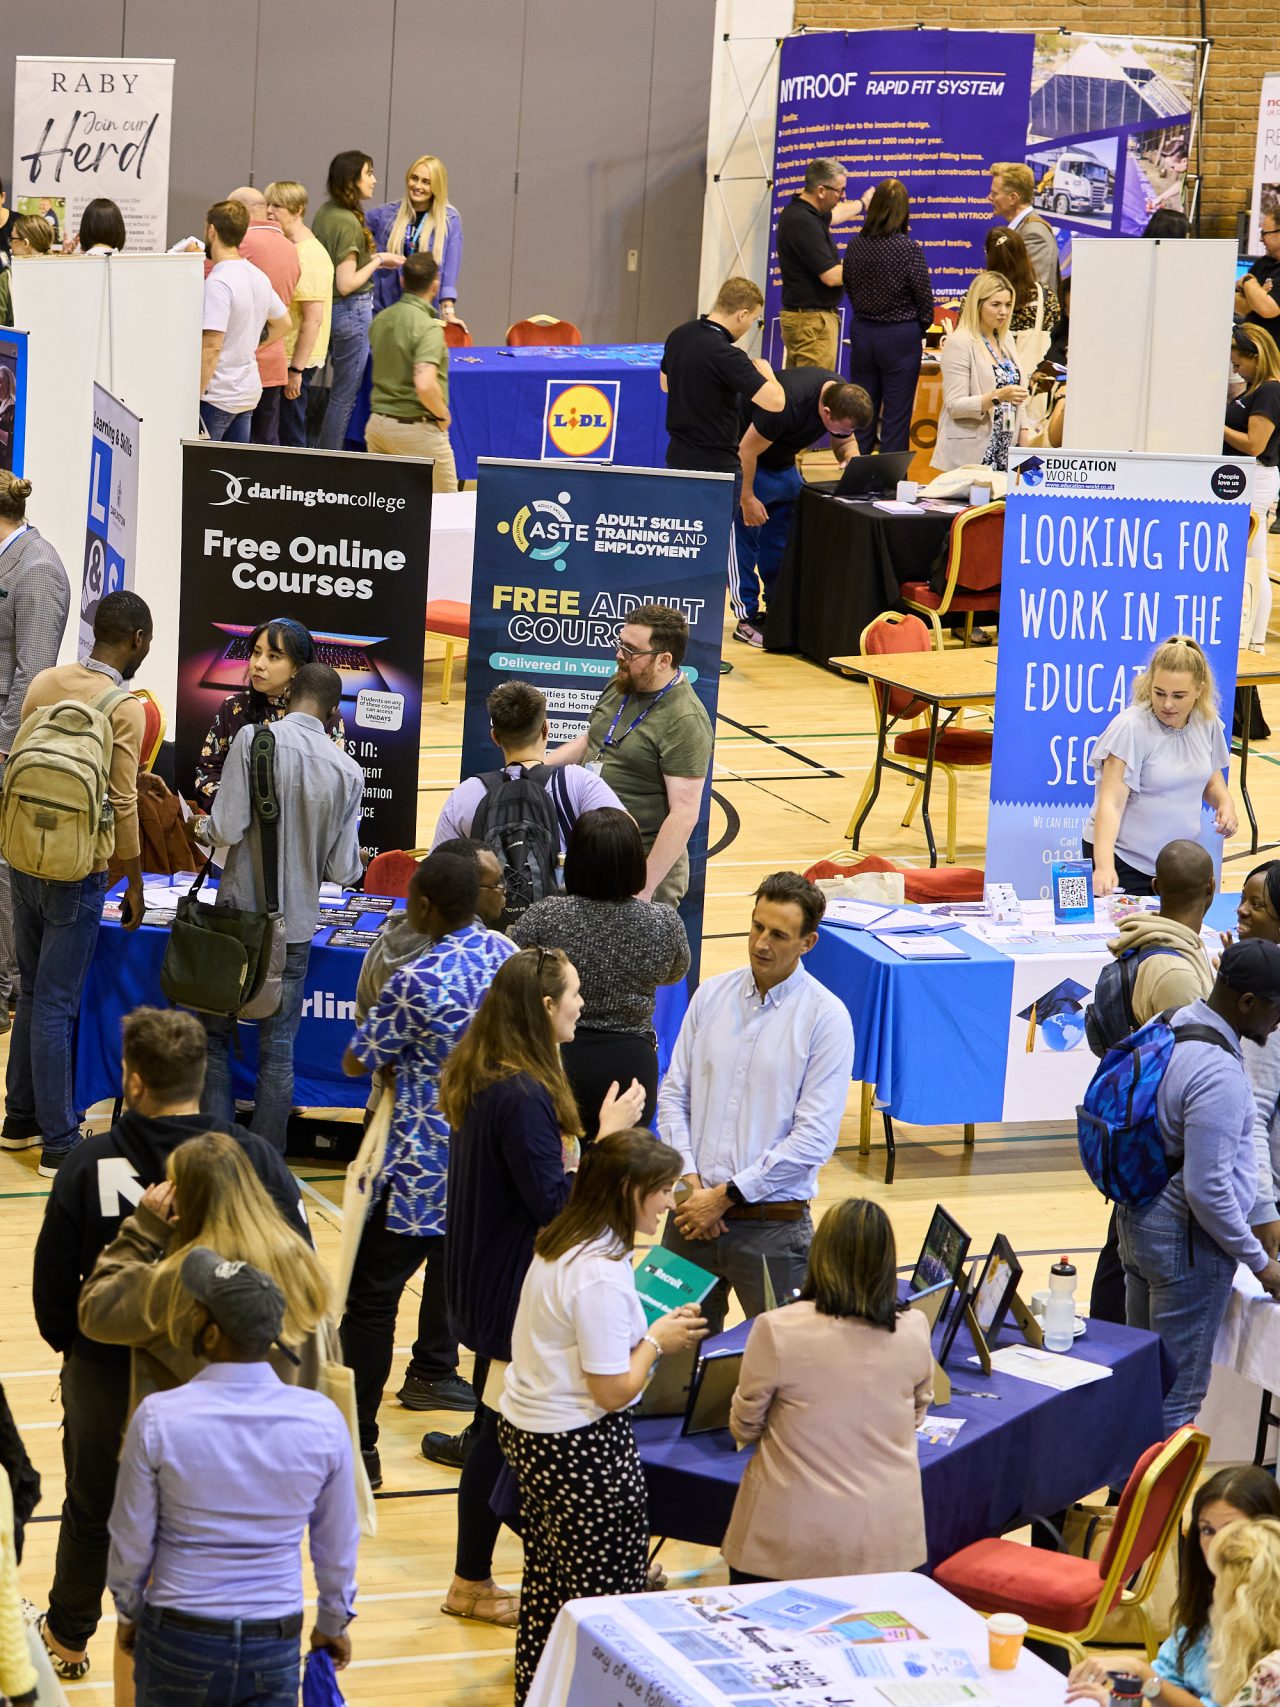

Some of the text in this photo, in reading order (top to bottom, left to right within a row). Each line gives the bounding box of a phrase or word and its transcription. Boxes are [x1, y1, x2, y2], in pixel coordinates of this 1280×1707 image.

[51, 72, 139, 94] RABY
[780, 72, 859, 103] NYTROOF
[866, 80, 1006, 96] RAPID FIT SYSTEM
[83, 110, 148, 135] Join our
[864, 121, 873, 129] the
[907, 121, 931, 129] design.
[21, 109, 160, 184] Herd
[883, 153, 912, 161] specialist
[913, 153, 938, 161] regional
[927, 196, 967, 204] Sustainable
[958, 212, 994, 220] NYTROOF
[925, 239, 972, 248] sound testing.
[943, 267, 964, 276] falling
[93, 410, 115, 446] Learning
[115, 429, 120, 446] &
[1046, 458, 1117, 472] EDUCATION
[1046, 470, 1088, 483] WORLD
[529, 521, 590, 542] ASTE
[596, 513, 704, 532] ADULT SKILLS
[596, 527, 708, 546] TRAINING AND
[1019, 513, 1230, 574] LOOKING FOR
[203, 529, 407, 571] Free Online
[594, 540, 700, 559] EMPLOYMENT
[232, 562, 374, 600] Courses
[492, 585, 580, 616] FREE
[1019, 587, 1223, 646] WORK IN THE
[499, 656, 610, 674] Delivered In Your
[580, 692, 602, 701] Stud
[1024, 662, 1144, 713] EDUCA
[360, 696, 383, 704] Students
[548, 700, 565, 709] and
[548, 731, 577, 740] ourses
[562, 722, 590, 731] Profes
[360, 741, 378, 758] IN:
[1047, 734, 1096, 787] SEC
[1060, 837, 1078, 846] Call
[1042, 849, 1081, 864] 0191
[592, 1646, 643, 1697] any of the
